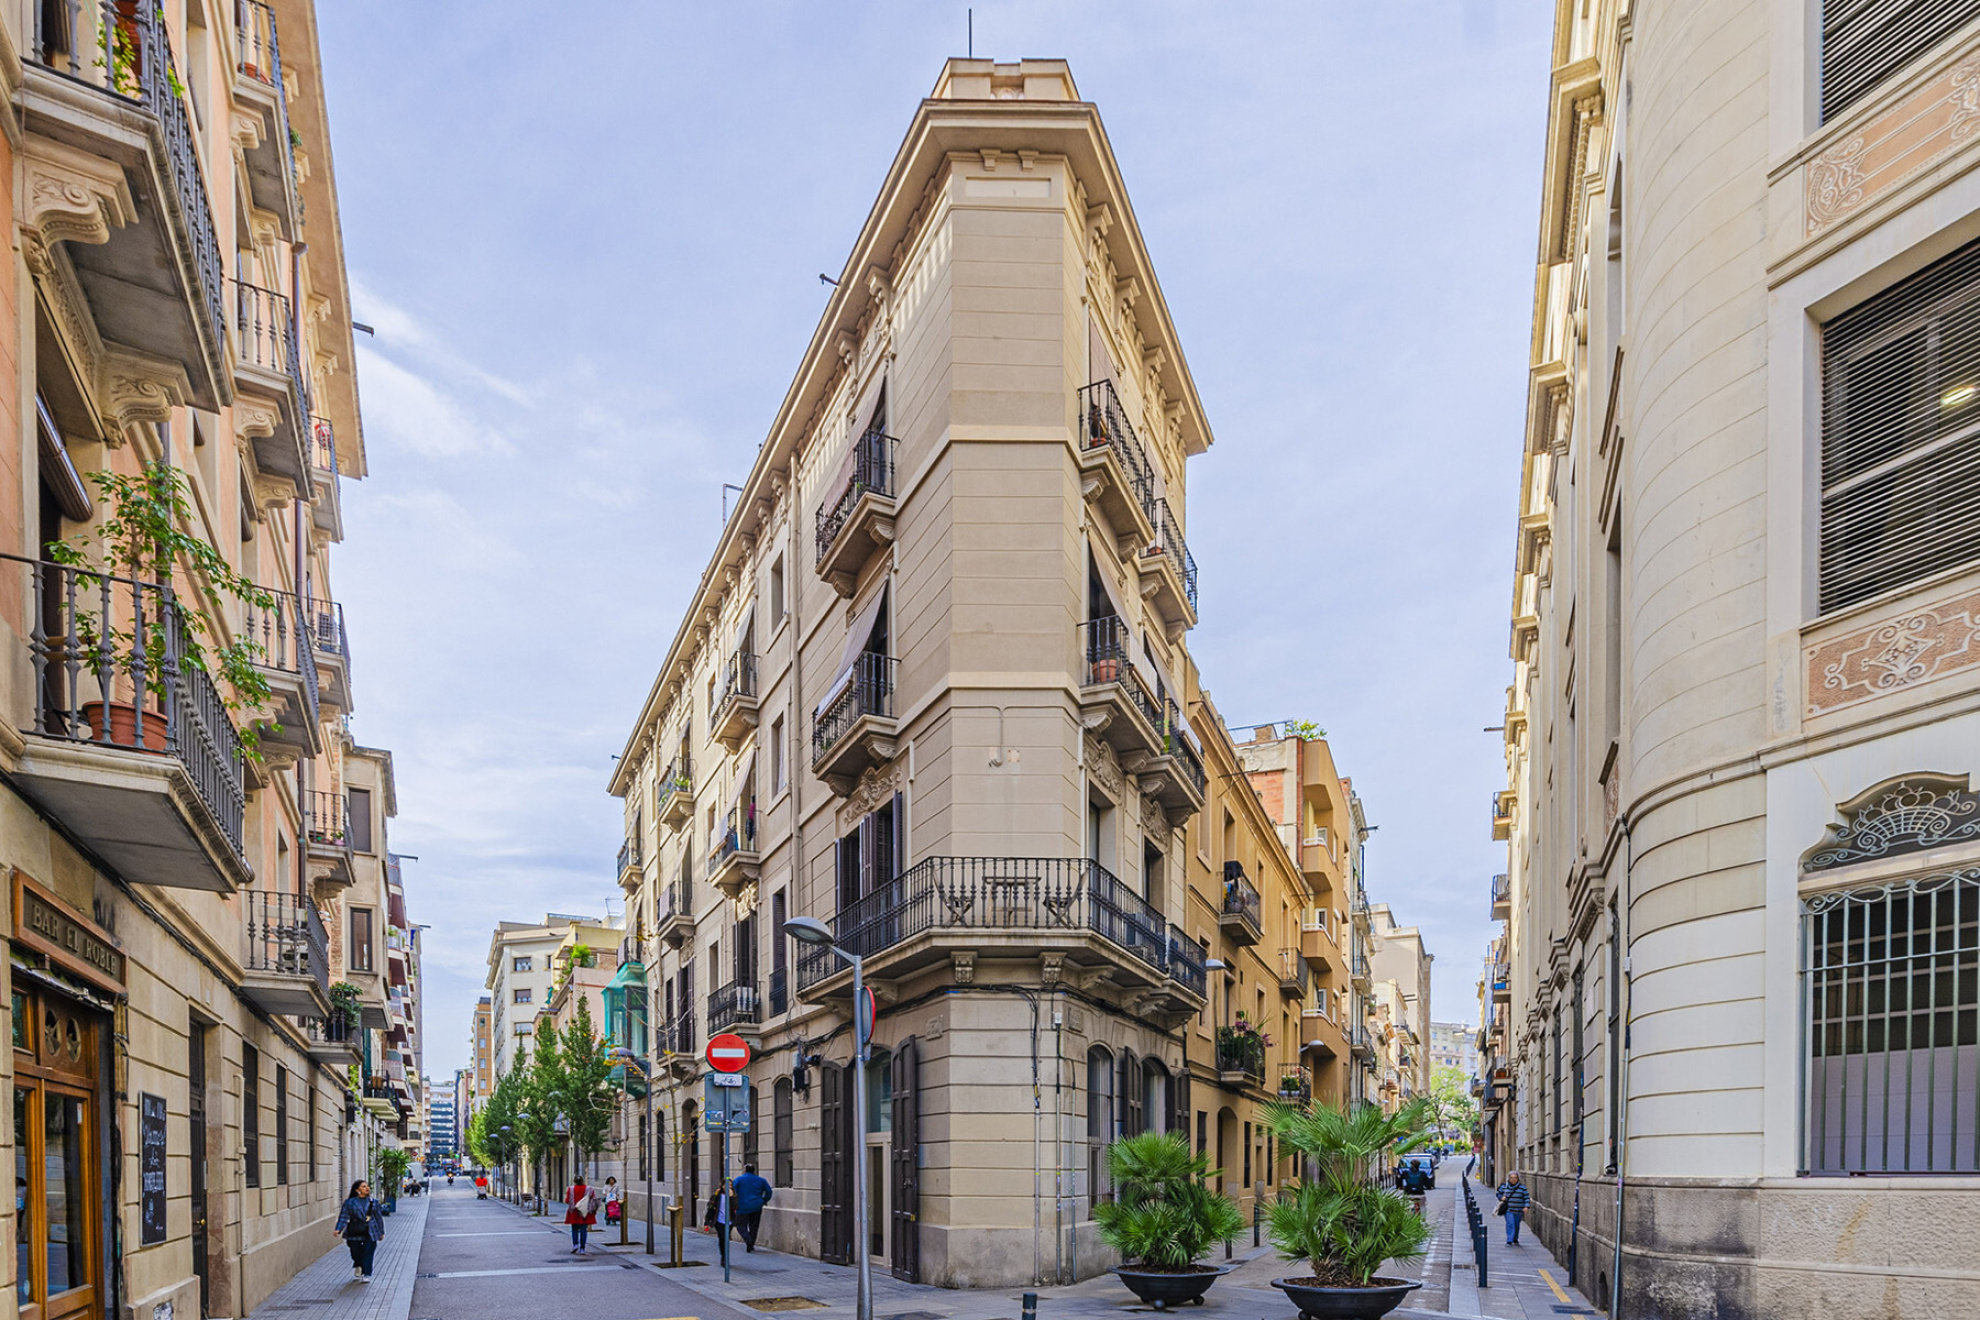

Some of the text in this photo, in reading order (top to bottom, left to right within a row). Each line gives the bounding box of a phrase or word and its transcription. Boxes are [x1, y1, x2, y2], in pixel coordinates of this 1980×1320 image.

[34, 904, 115, 975] BAR EL ROBLE
